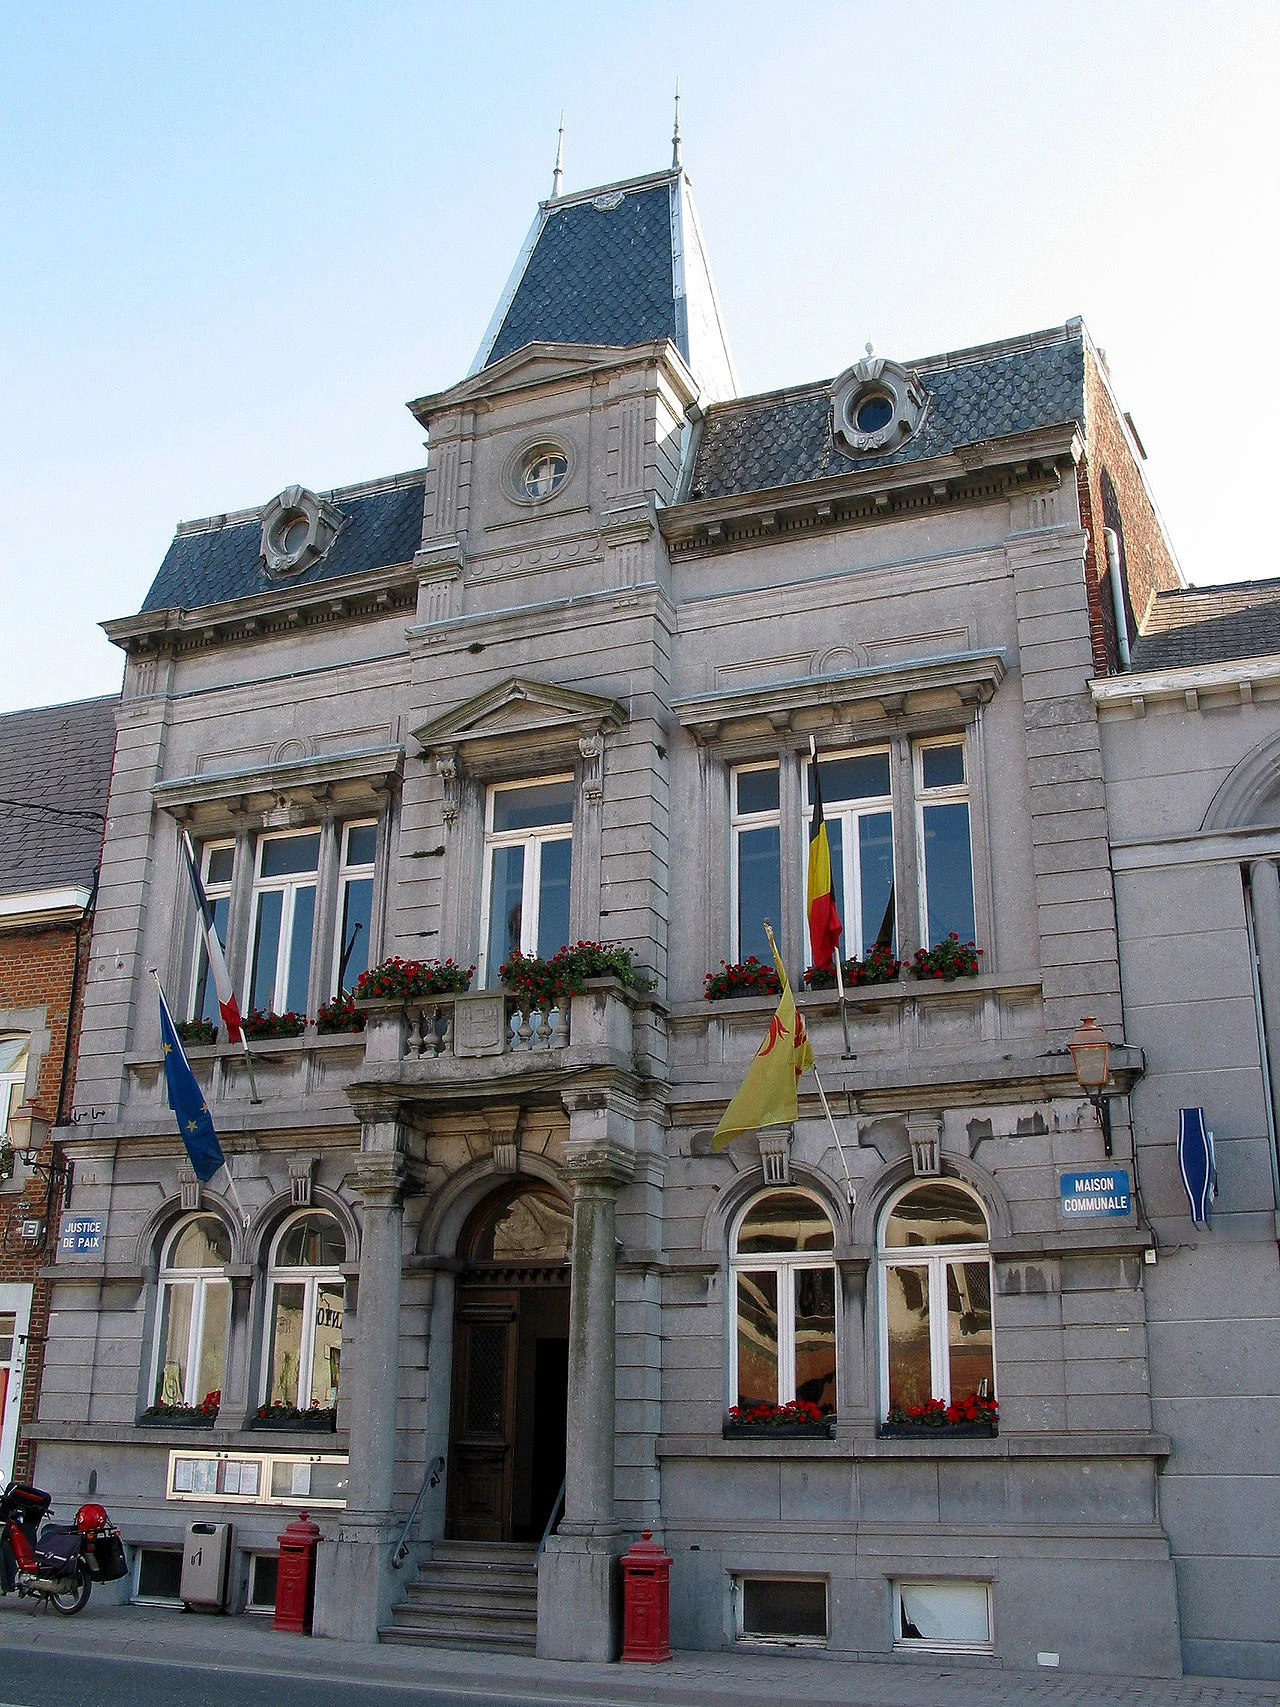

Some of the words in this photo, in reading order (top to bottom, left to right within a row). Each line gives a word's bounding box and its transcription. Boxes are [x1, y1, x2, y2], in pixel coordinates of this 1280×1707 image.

[1075, 1178, 1114, 1192] MAISON
[1064, 1196, 1127, 1212] COMMUNALE
[65, 1222, 101, 1233] JUSTICE
[63, 1238, 75, 1247] DE
[78, 1238, 99, 1247] PAIX
